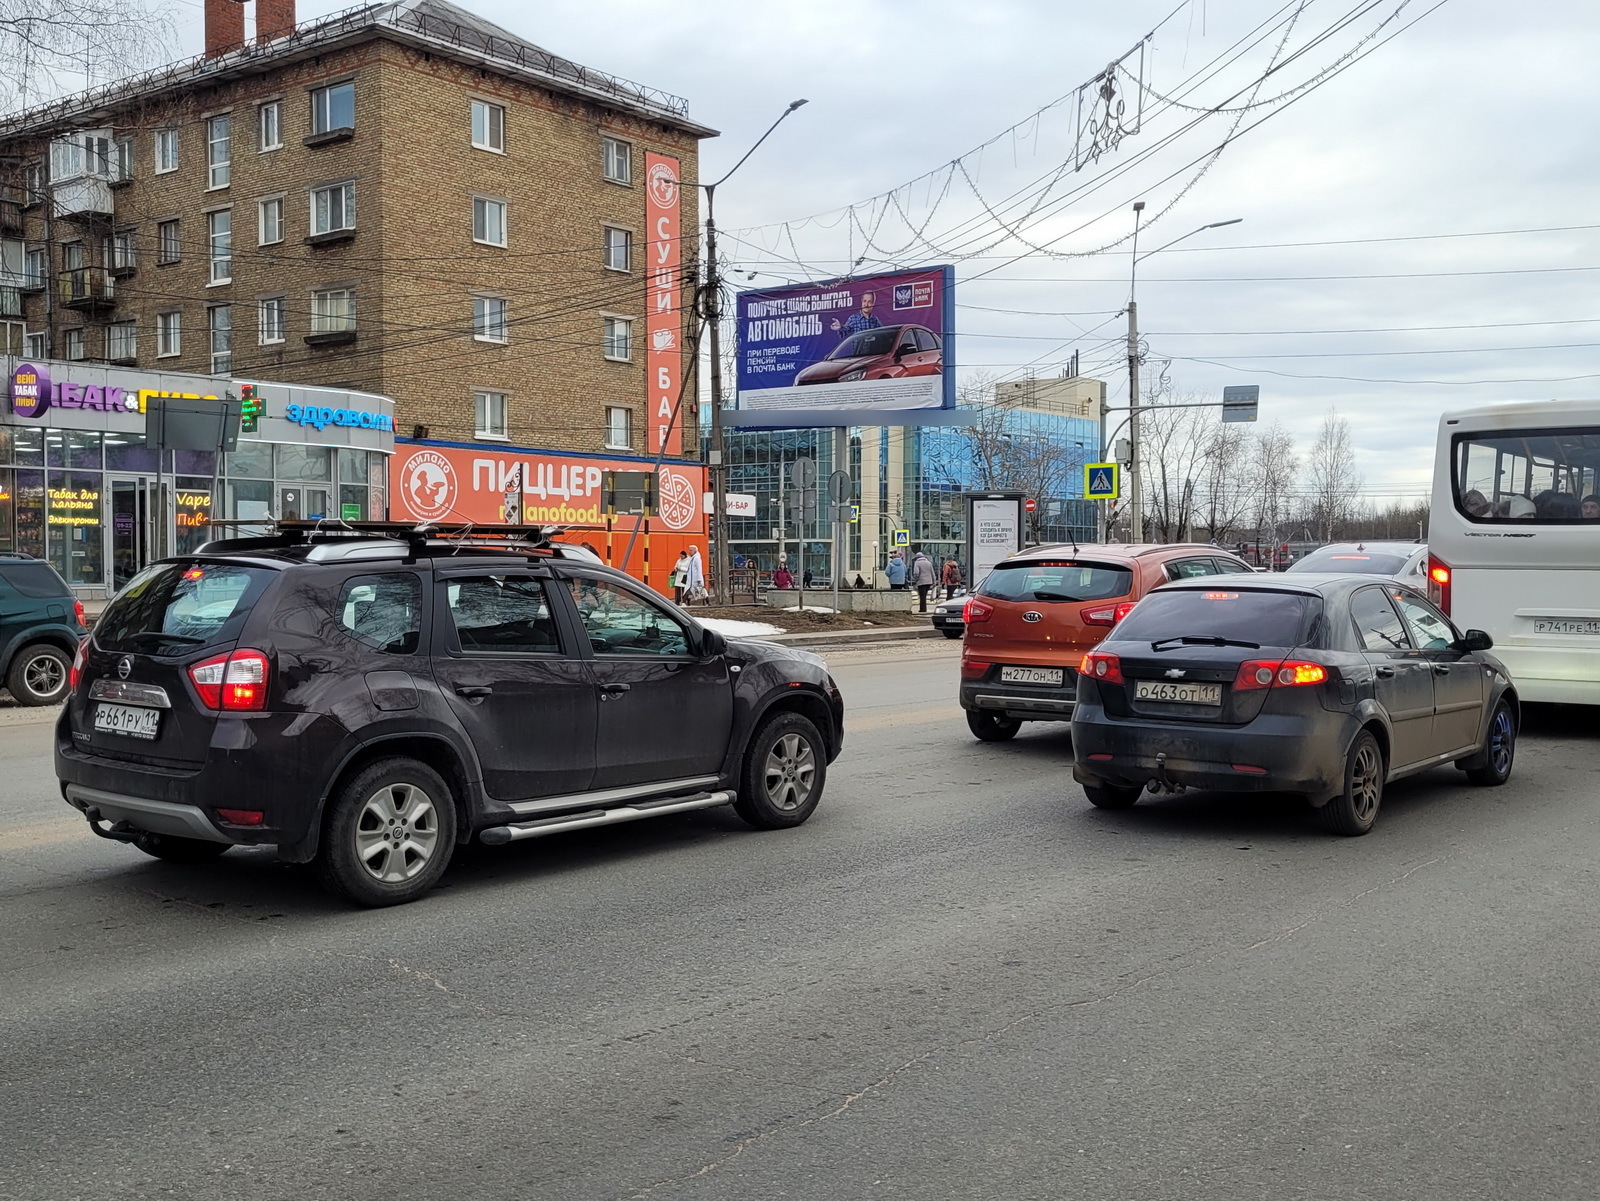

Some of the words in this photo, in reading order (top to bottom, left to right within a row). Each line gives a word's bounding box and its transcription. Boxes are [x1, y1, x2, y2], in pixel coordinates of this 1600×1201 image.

[655, 216, 672, 315] СУШИ
[915, 287, 930, 295] ПОЧТА
[747, 299, 787, 318] ПОЛУЧИТЕ
[787, 295, 811, 312] ШАНС
[811, 290, 853, 311] ВЫИГРАТЬ
[747, 313, 823, 343] АВТОМОБИЛЬ
[747, 349, 762, 358] ПРИ
[763, 345, 800, 357] ПЕРЕВОДЕ
[747, 356, 777, 366] ПЕНСИИ
[747, 366, 753, 374] В
[753, 364, 776, 373] ПОЧТА
[777, 362, 796, 371] БАНК
[16, 371, 36, 384] ВЕЙП
[14, 384, 38, 396] ТАБАК
[15, 396, 36, 407] ПИВО
[657, 366, 673, 447] БАР
[48, 489, 78, 500] Табак
[80, 489, 98, 500] для
[52, 500, 94, 509] кальяна
[176, 493, 211, 510] Vape
[48, 515, 99, 526] Электронки
[1025, 613, 1040, 621] KIA
